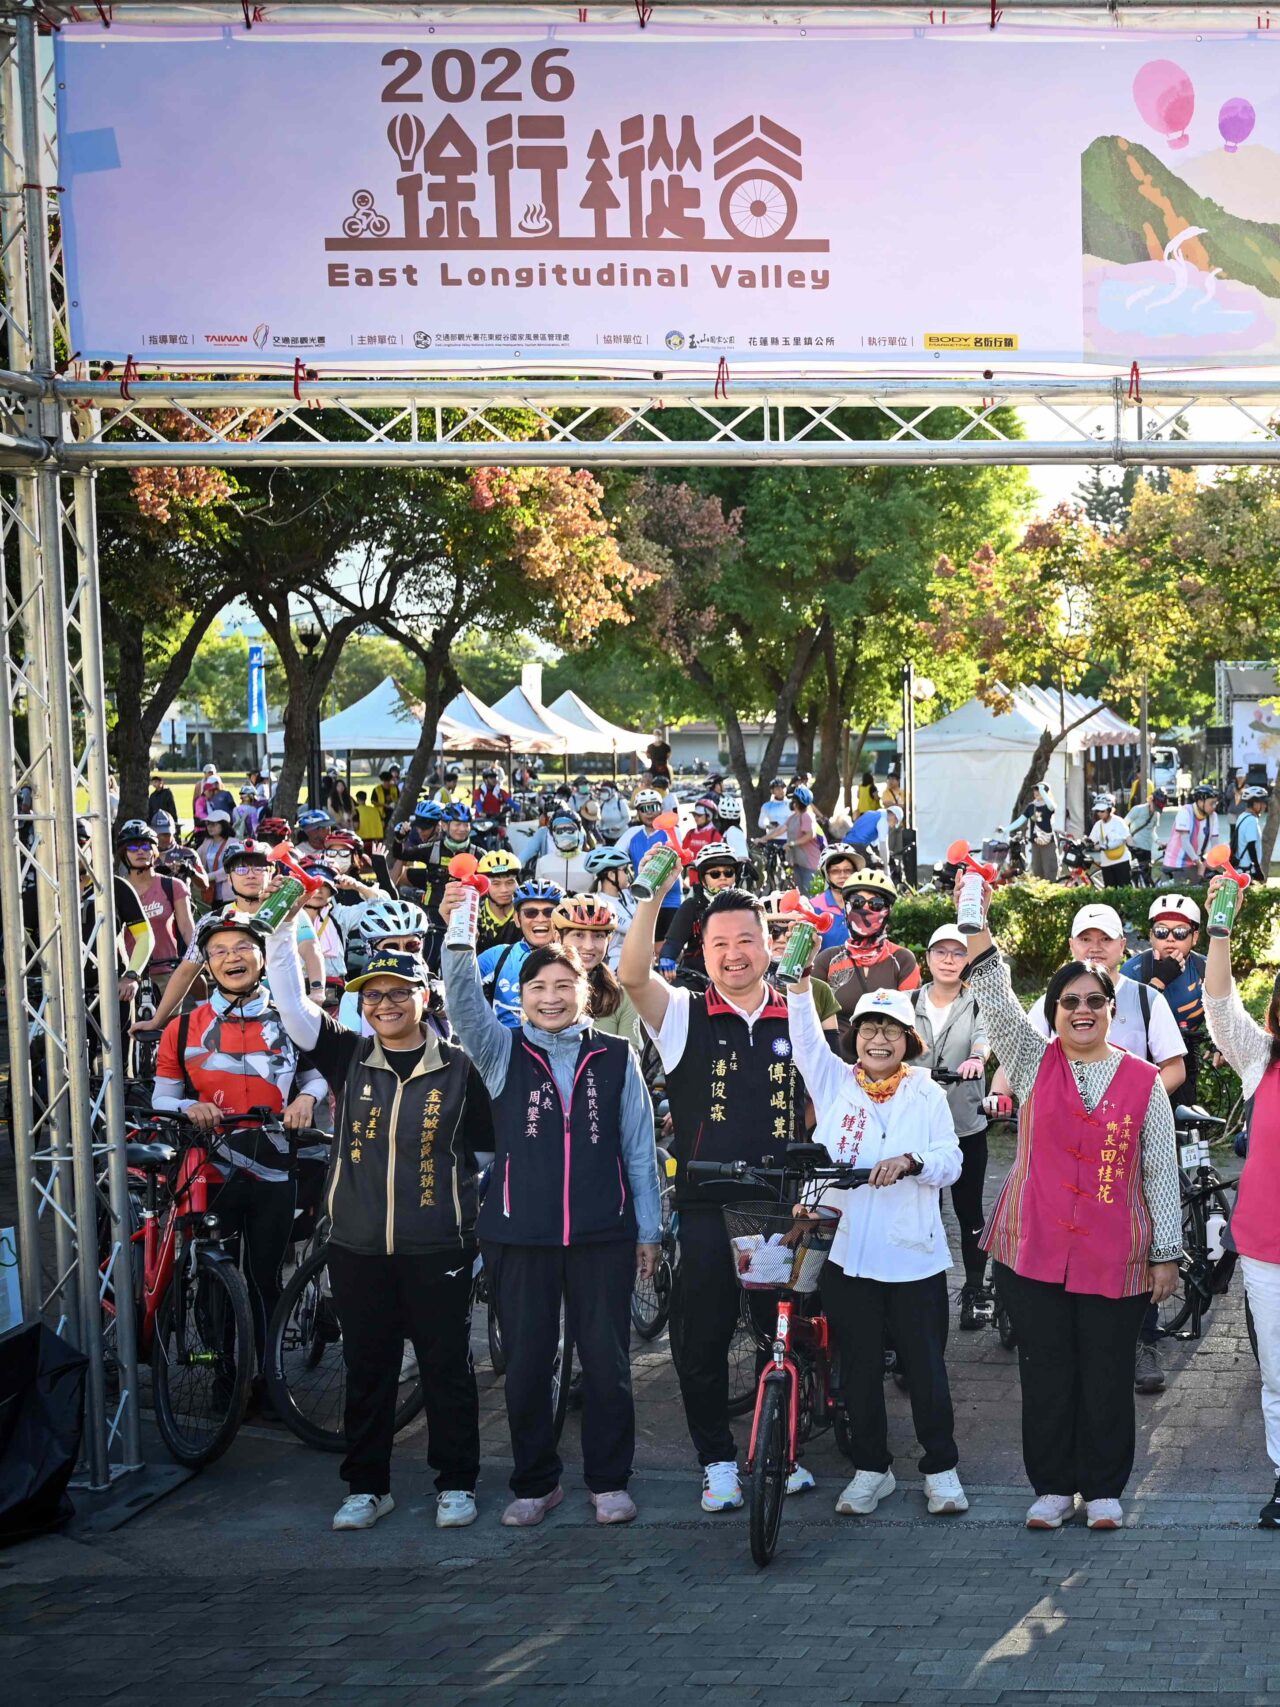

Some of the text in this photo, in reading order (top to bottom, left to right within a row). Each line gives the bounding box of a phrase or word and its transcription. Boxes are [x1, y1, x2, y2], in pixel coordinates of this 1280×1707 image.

[381, 47, 575, 103] 2026
[387, 112, 802, 239] 徐行縱谷
[328, 262, 831, 290] East Longitudinal Valley
[149, 334, 189, 345] 指導單位
[205, 335, 248, 343] TAIWAN
[273, 335, 326, 344] 交通部觀光署
[358, 334, 397, 345] 主辦單位
[603, 334, 642, 345] 協辦單位
[748, 336, 835, 346] 花蓮縣玉里鎮公所
[868, 336, 907, 347] 執行單位
[729, 1050, 739, 1071] 主任
[540, 1081, 554, 1111] 代表
[710, 1058, 728, 1122] 潘俊霖
[585, 1067, 601, 1144] 玉里鎮民代表會
[419, 1087, 444, 1208] 金淑敏議員服務處
[835, 1113, 858, 1164] 鍾素
[1114, 1113, 1134, 1180] 卓溪鄉公所
